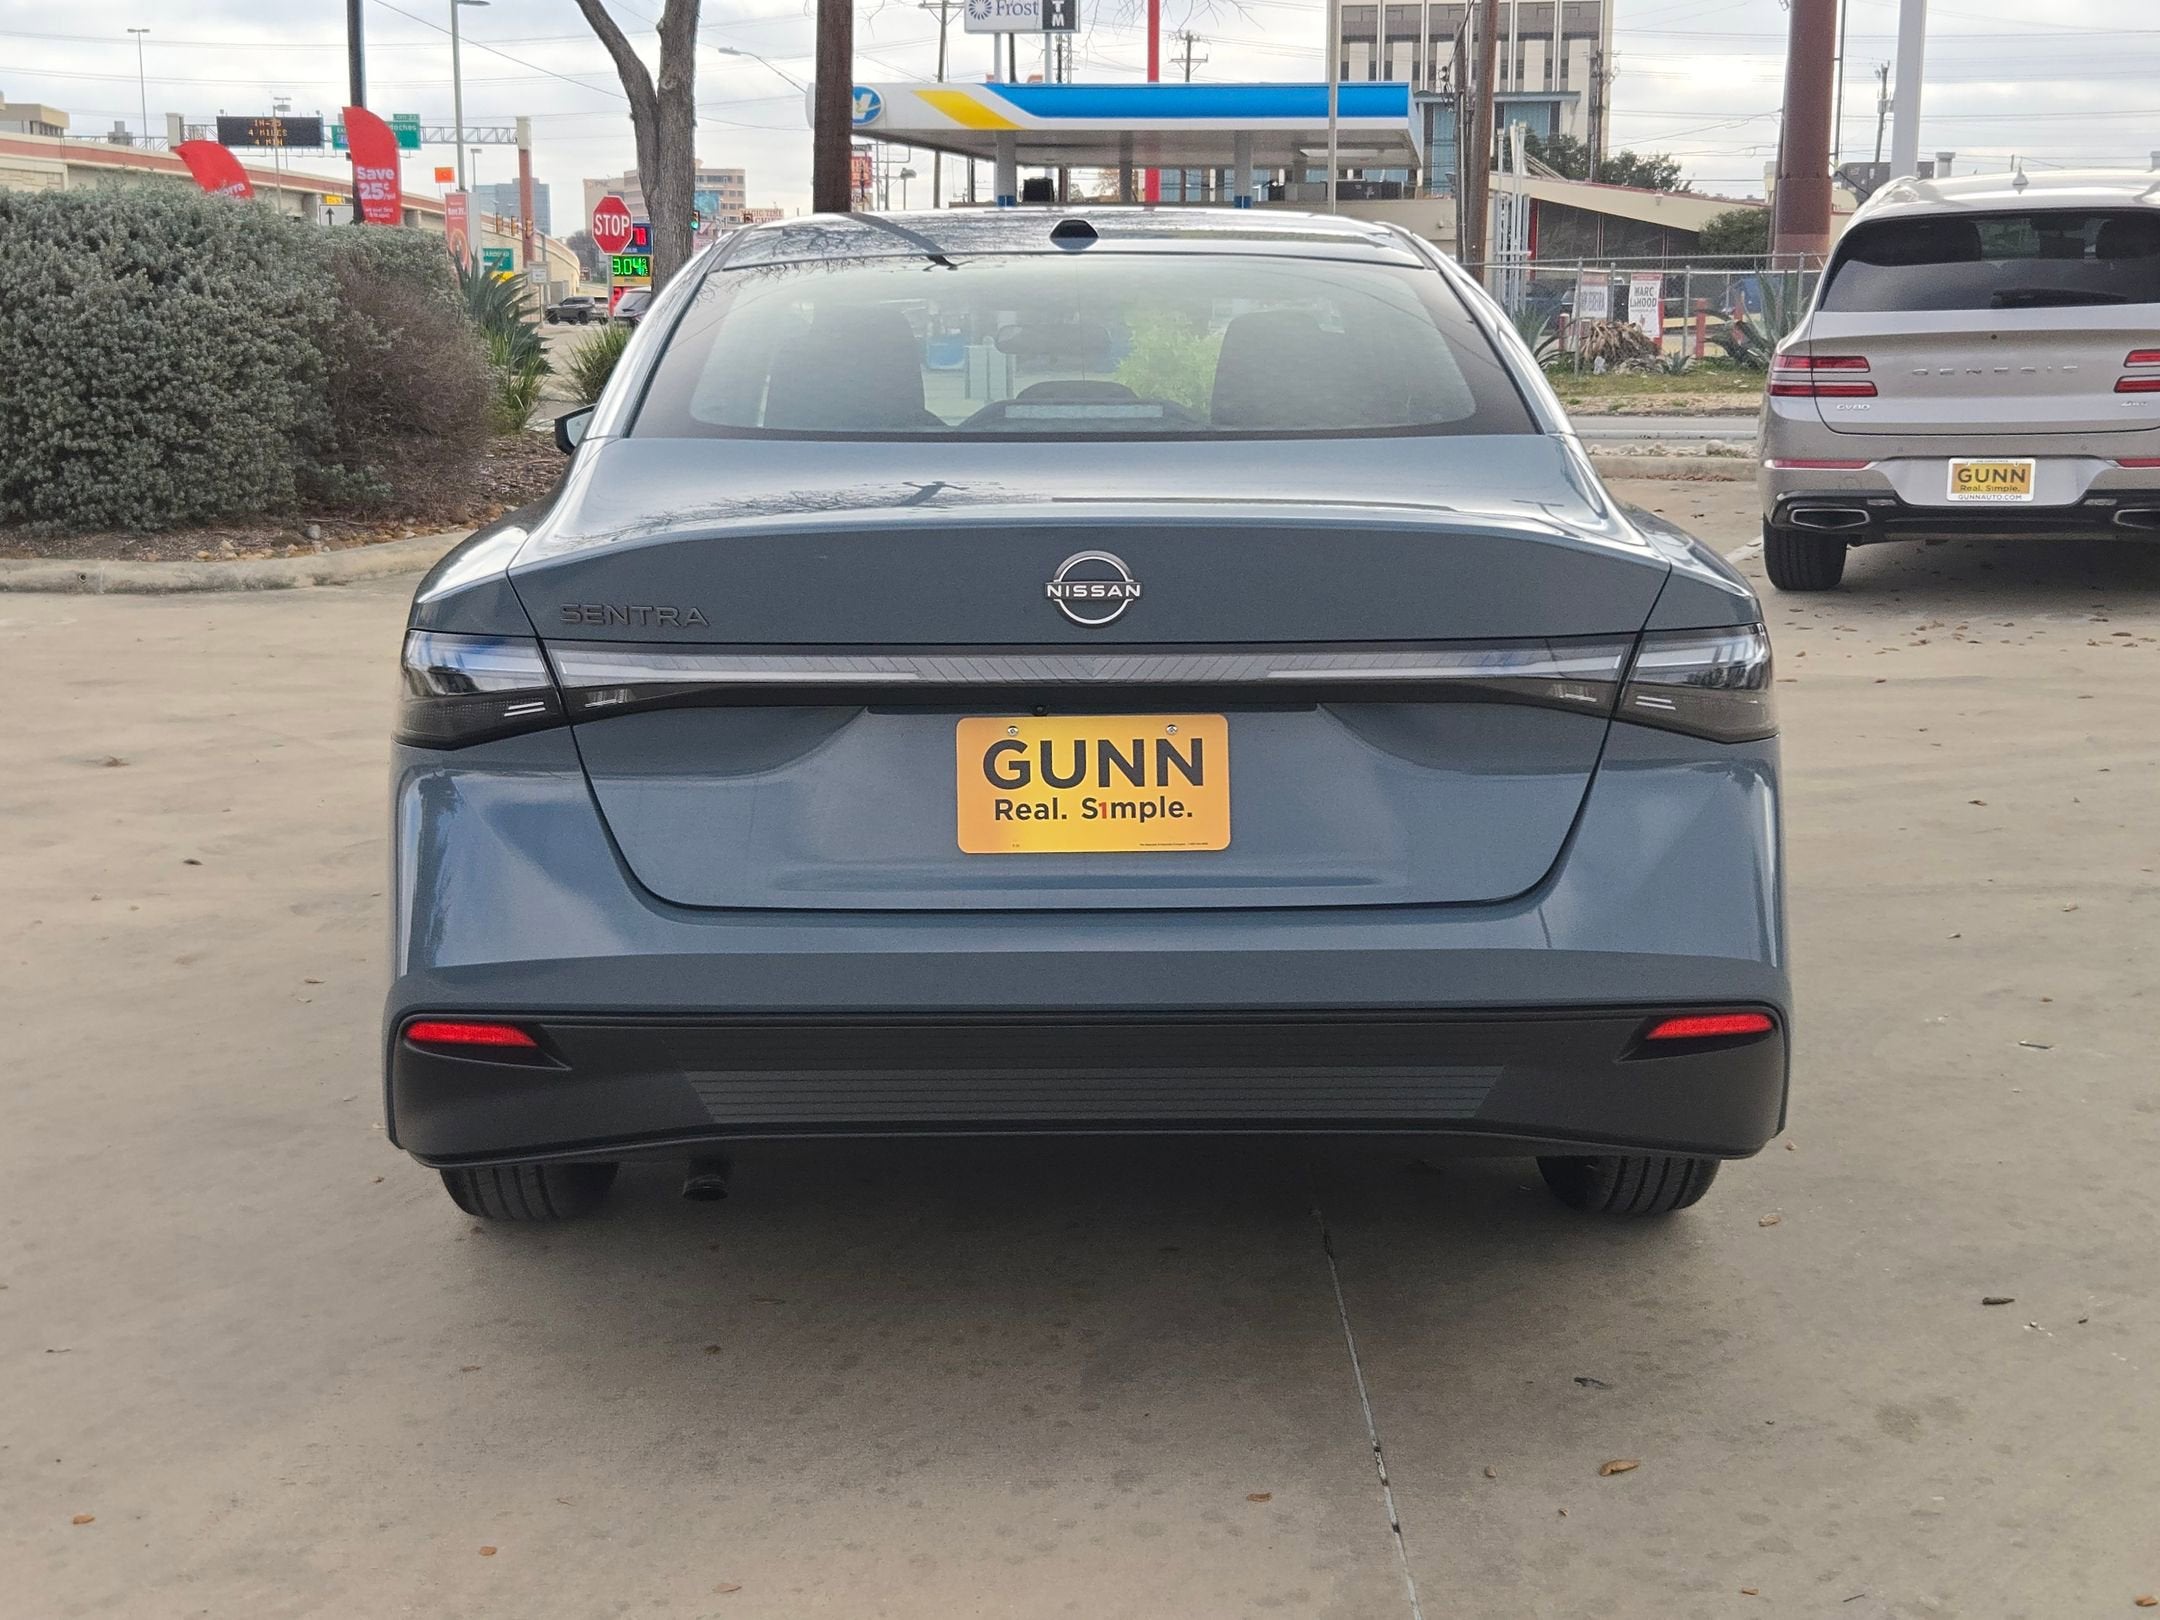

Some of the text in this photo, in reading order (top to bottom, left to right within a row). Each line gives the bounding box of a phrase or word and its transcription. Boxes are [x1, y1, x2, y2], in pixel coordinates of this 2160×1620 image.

[996, 0, 1039, 16] Frost
[357, 166, 395, 180] Save
[595, 214, 630, 237] STOP
[1634, 286, 1654, 297] MARC
[1958, 468, 2026, 484] GUNN
[1960, 484, 1983, 492] Real.
[1046, 584, 1141, 598] NISSAN
[559, 603, 712, 628] SENTRA
[982, 737, 1205, 791] GUNN
[994, 797, 1068, 821] Real.
